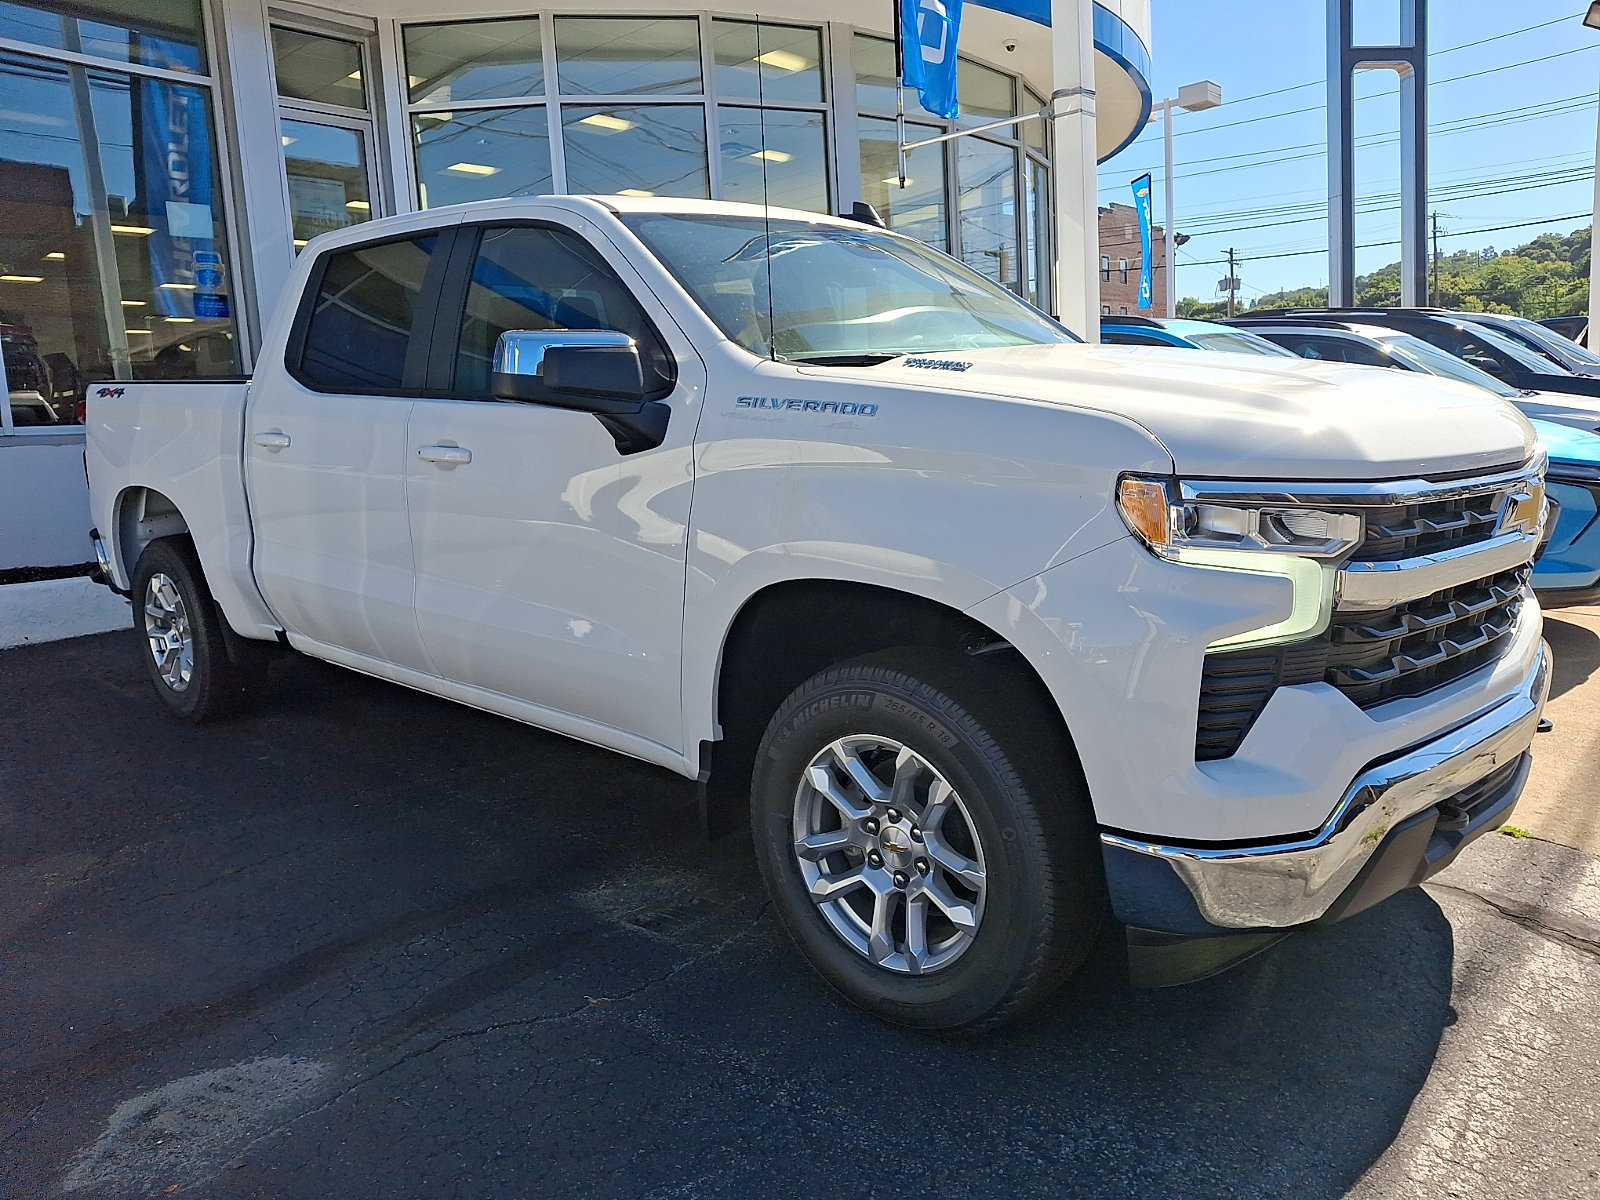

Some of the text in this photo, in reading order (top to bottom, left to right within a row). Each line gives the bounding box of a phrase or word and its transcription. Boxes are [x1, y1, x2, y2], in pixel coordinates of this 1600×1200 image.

[735, 396, 879, 417] SILVERADO
[792, 693, 951, 743] MICHELIN 265/65 R 18
